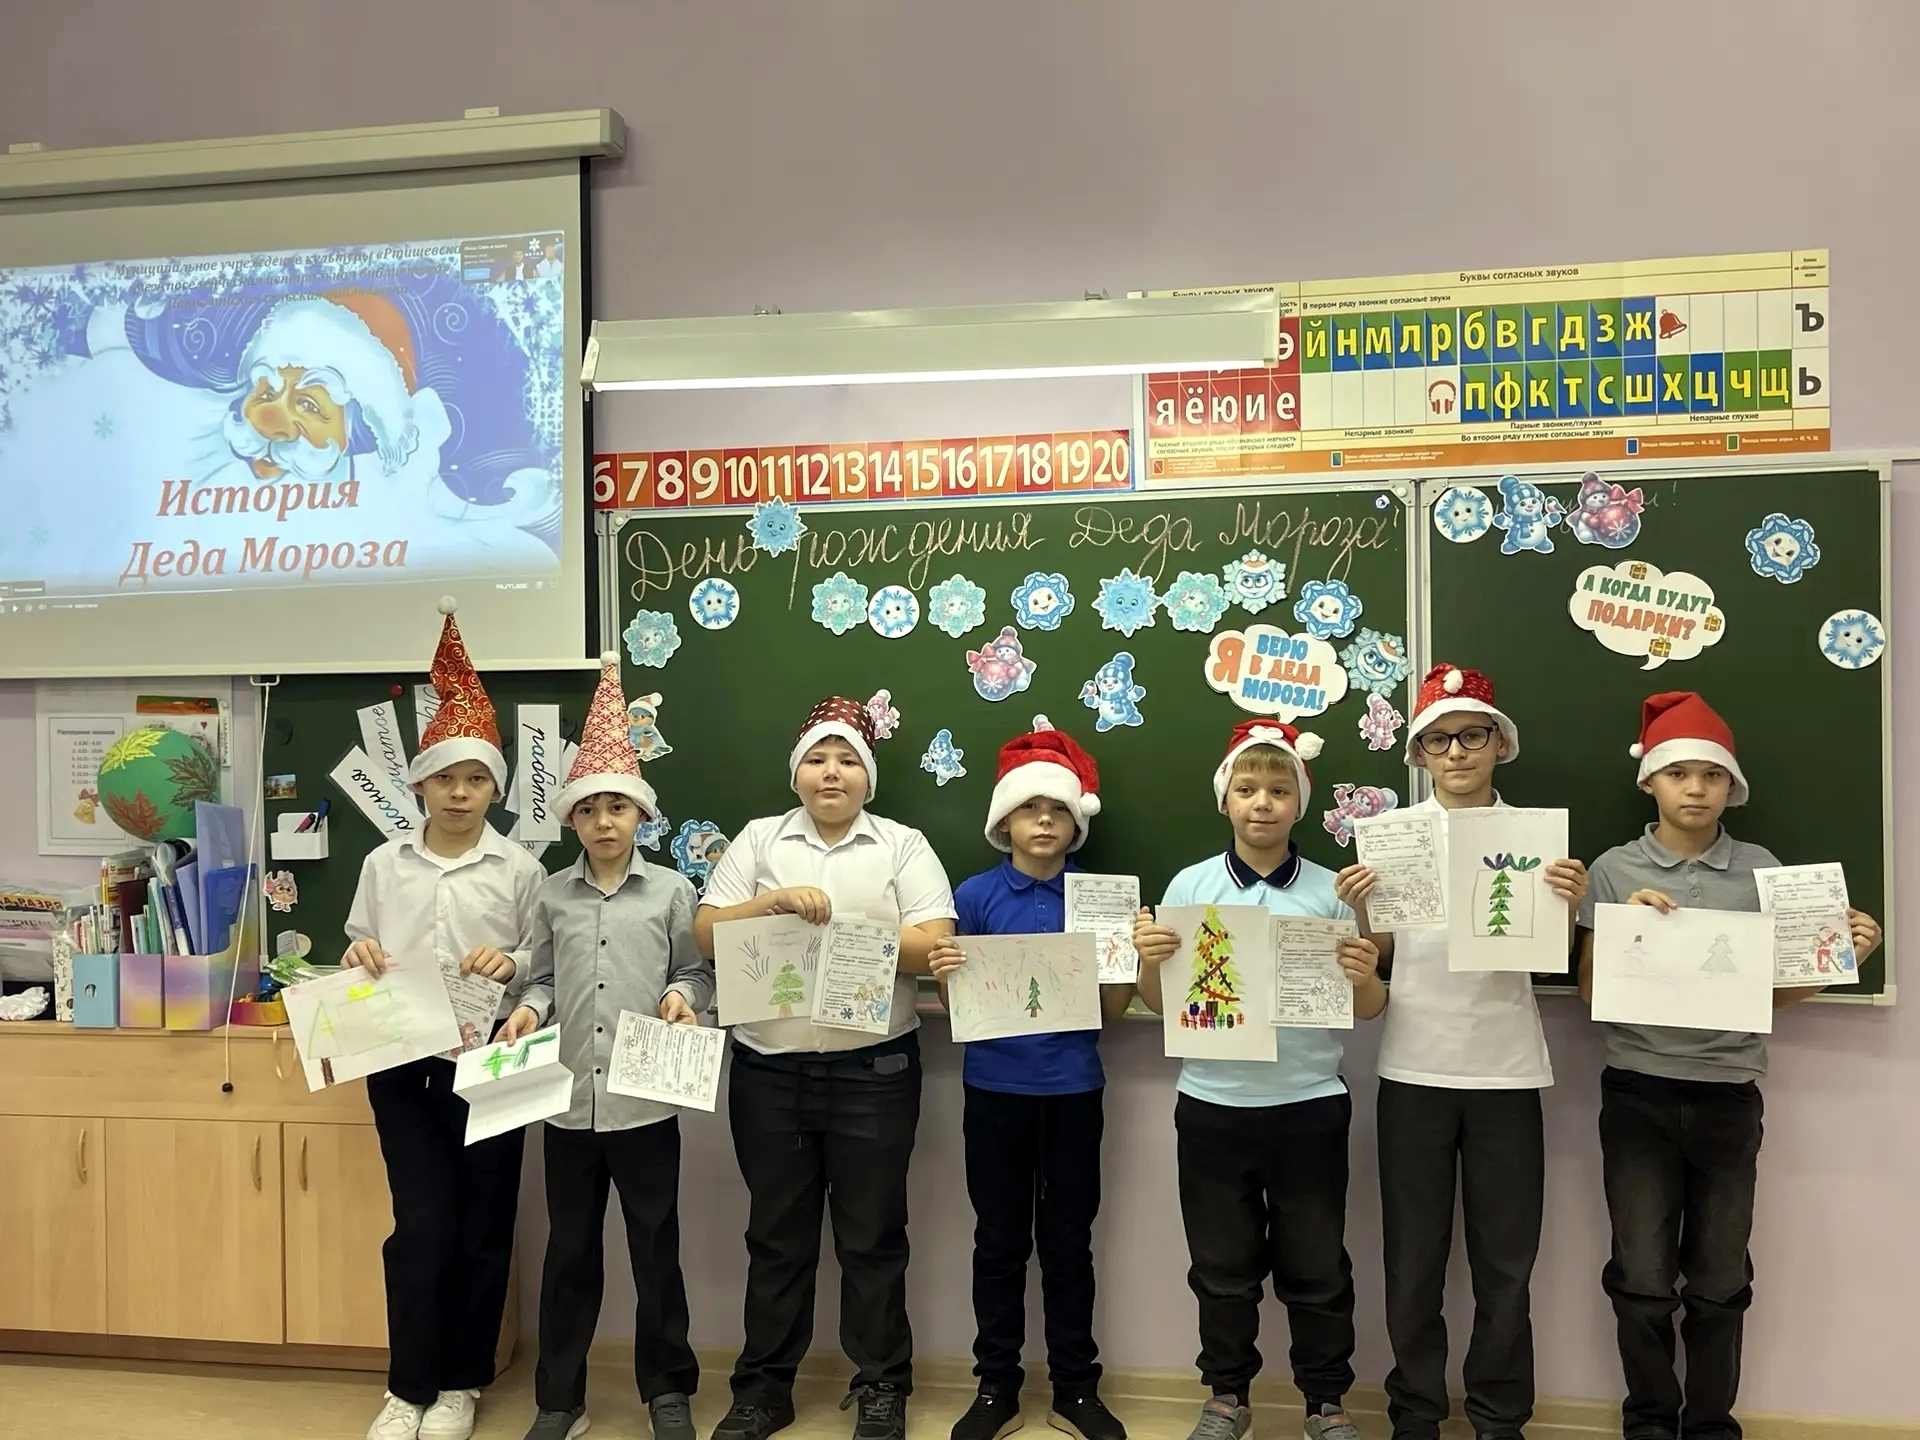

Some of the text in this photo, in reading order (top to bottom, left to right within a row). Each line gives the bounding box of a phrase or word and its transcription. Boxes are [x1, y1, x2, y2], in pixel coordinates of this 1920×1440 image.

[376, 245, 461, 260] «Ртищевска
[1459, 267, 1579, 283] Буквы согласных звуков
[1310, 302, 1337, 310] первом
[1339, 300, 1356, 309] ряду
[1358, 299, 1388, 307] звонкие
[1390, 296, 1428, 305] согласные
[1430, 294, 1451, 304] звуки
[1344, 427, 1414, 438] Непарные звонкие
[1461, 428, 1614, 442] Во втором ряду глухие согласные звуки
[1510, 421, 1540, 431] Парные
[1690, 411, 1760, 424] Непарные глухие
[593, 460, 616, 503] 6
[622, 460, 649, 502] 7
[656, 458, 685, 501] 8
[691, 456, 720, 500] 9
[724, 455, 759, 498] 10
[760, 454, 793, 497] 11
[795, 452, 831, 496] 12
[831, 450, 867, 494] 13
[868, 449, 903, 493] 14
[905, 447, 941, 491] 15
[942, 445, 978, 489] 16
[979, 443, 1015, 488] 17
[1016, 441, 1052, 487] 18
[1054, 439, 1091, 484] 19
[1093, 437, 1130, 483] 20
[156, 479, 360, 522] История
[118, 536, 409, 589] Деда Мороза
[626, 531, 757, 602] День
[787, 511, 1046, 612] рождения
[1069, 505, 1203, 585] Деда
[1583, 574, 1712, 614] А КОГДА БУДУТ
[1587, 599, 1697, 641] ПОДАРКИ?
[1213, 634, 1309, 684] Я ВЕРЮ
[1249, 655, 1321, 686] В ДЕДА
[1241, 678, 1326, 711] МОРОЗА!
[522, 723, 557, 825] работа
[351, 767, 416, 834] ассная
